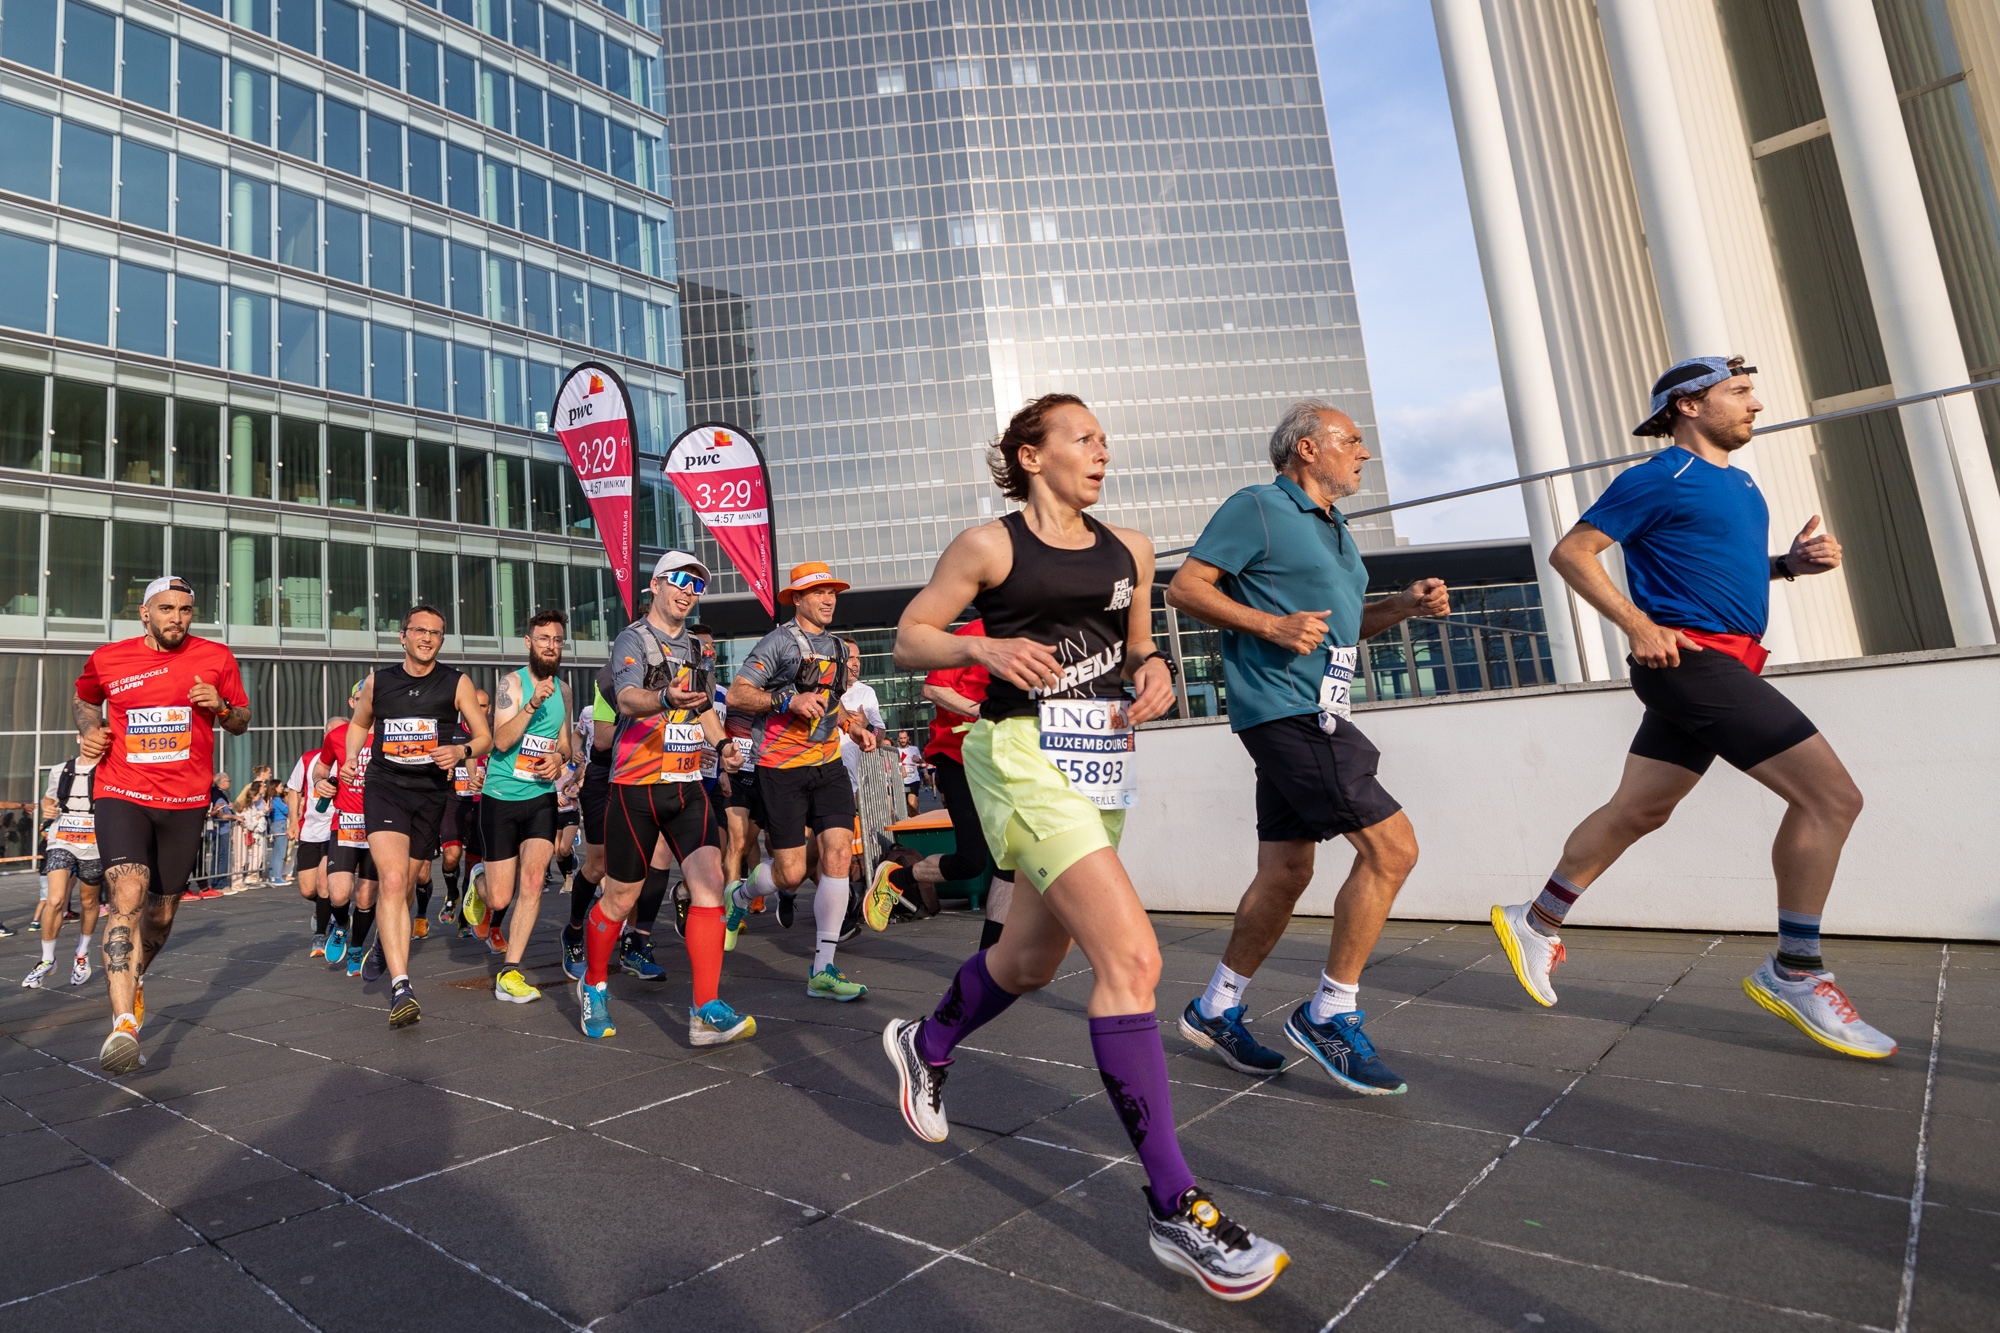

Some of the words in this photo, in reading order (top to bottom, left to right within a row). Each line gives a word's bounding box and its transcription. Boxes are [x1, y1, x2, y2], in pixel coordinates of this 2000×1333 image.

[568, 403, 593, 426] pwc
[577, 436, 617, 475] 3:29
[684, 453, 721, 471] pwc
[695, 480, 751, 509] 3:29
[755, 479, 761, 487] H
[738, 512, 762, 520] MIN/KM
[1114, 578, 1130, 592] FAT
[120, 680, 144, 692] LAFEN
[131, 711, 163, 723] ING
[1048, 706, 1106, 730] ING
[130, 725, 186, 734] LUXEMBOURG
[387, 722, 413, 732] ING
[140, 737, 178, 750] 1696
[386, 734, 433, 742] LUXEMBOURG
[1046, 736, 1129, 751] LUXEMBOURG
[395, 745, 425, 755] 1821
[525, 738, 548, 751] ING
[125, 790, 154, 801] INDEX
[61, 818, 80, 826] ING
[342, 814, 362, 822] ING
[65, 834, 87, 843] 1344
[1759, 971, 1780, 995] HOKA
[583, 992, 592, 1021] HOKA
